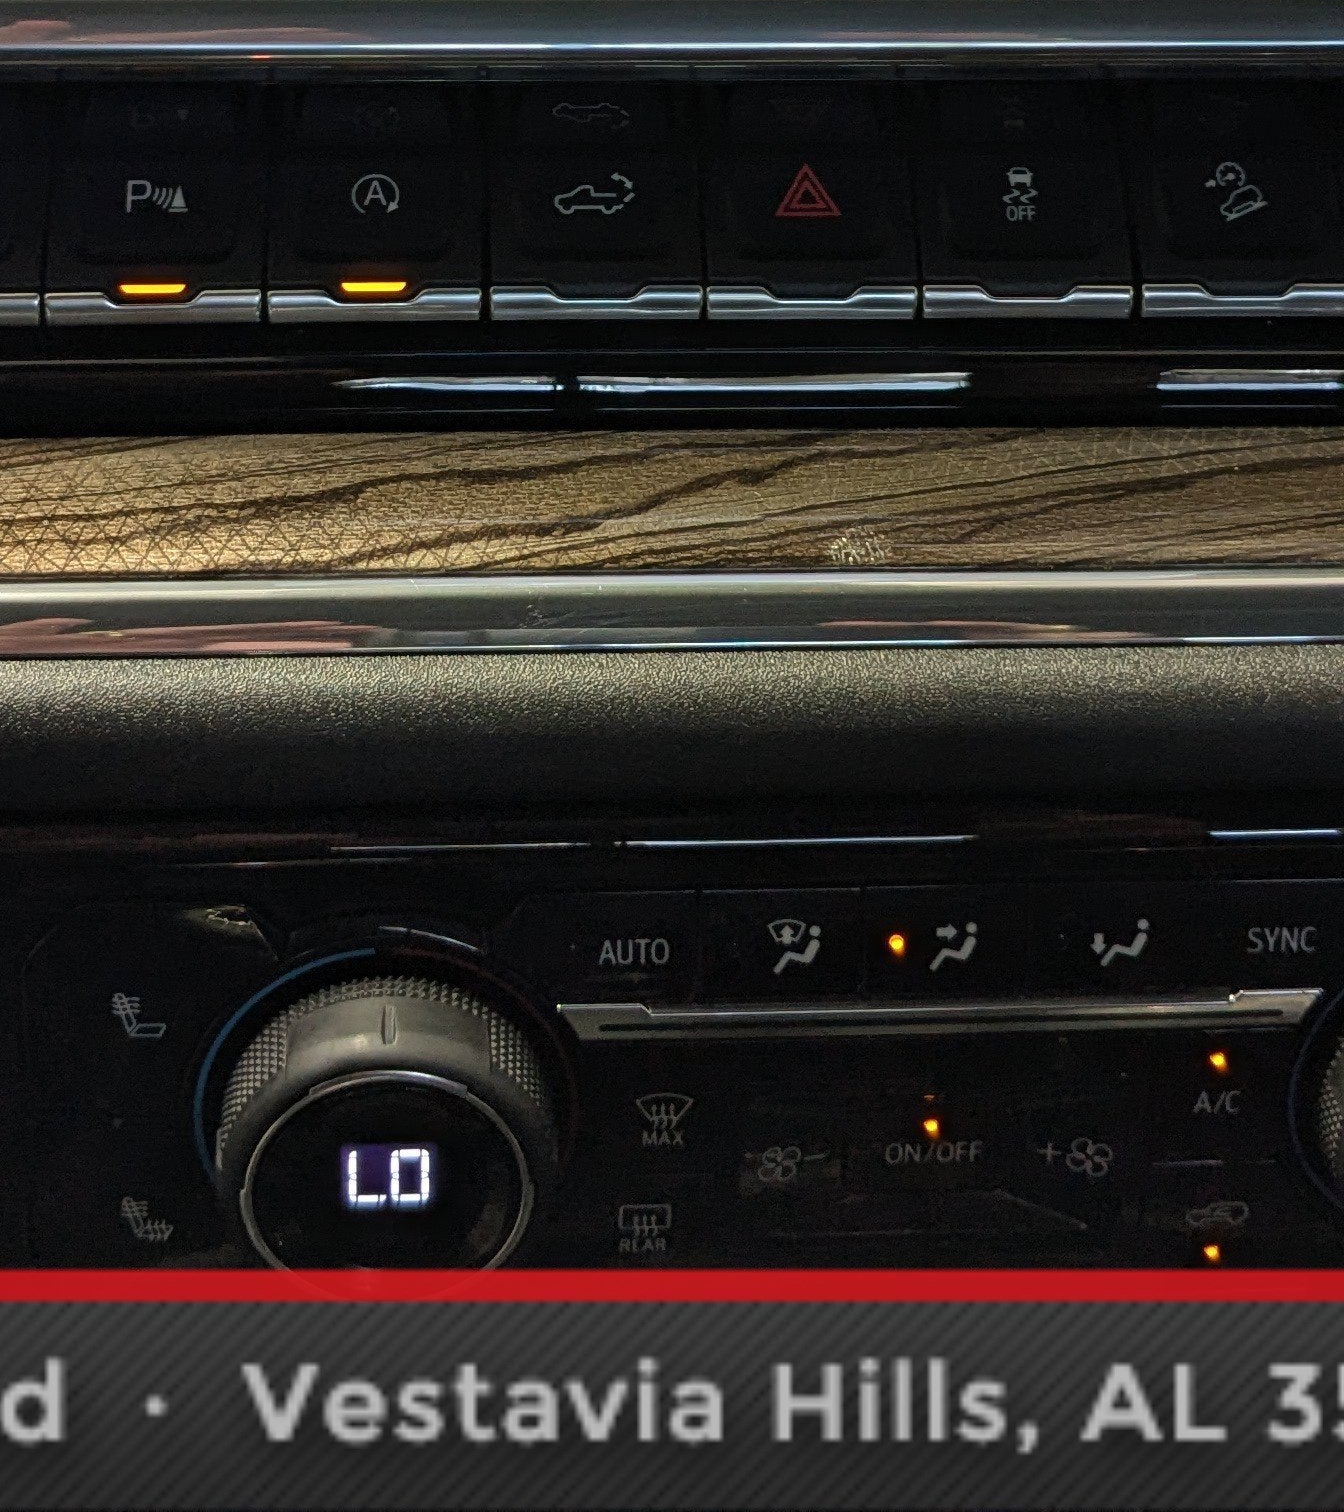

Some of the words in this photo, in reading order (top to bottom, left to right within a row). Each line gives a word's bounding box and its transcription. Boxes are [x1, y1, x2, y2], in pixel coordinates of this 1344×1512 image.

[1005, 205, 1037, 222] OFF
[599, 938, 671, 966] AUTO
[1246, 927, 1318, 955] SYNC
[1193, 1090, 1242, 1115] A/C
[642, 1130, 685, 1147] MAX
[884, 1139, 984, 1166] ON/OFF
